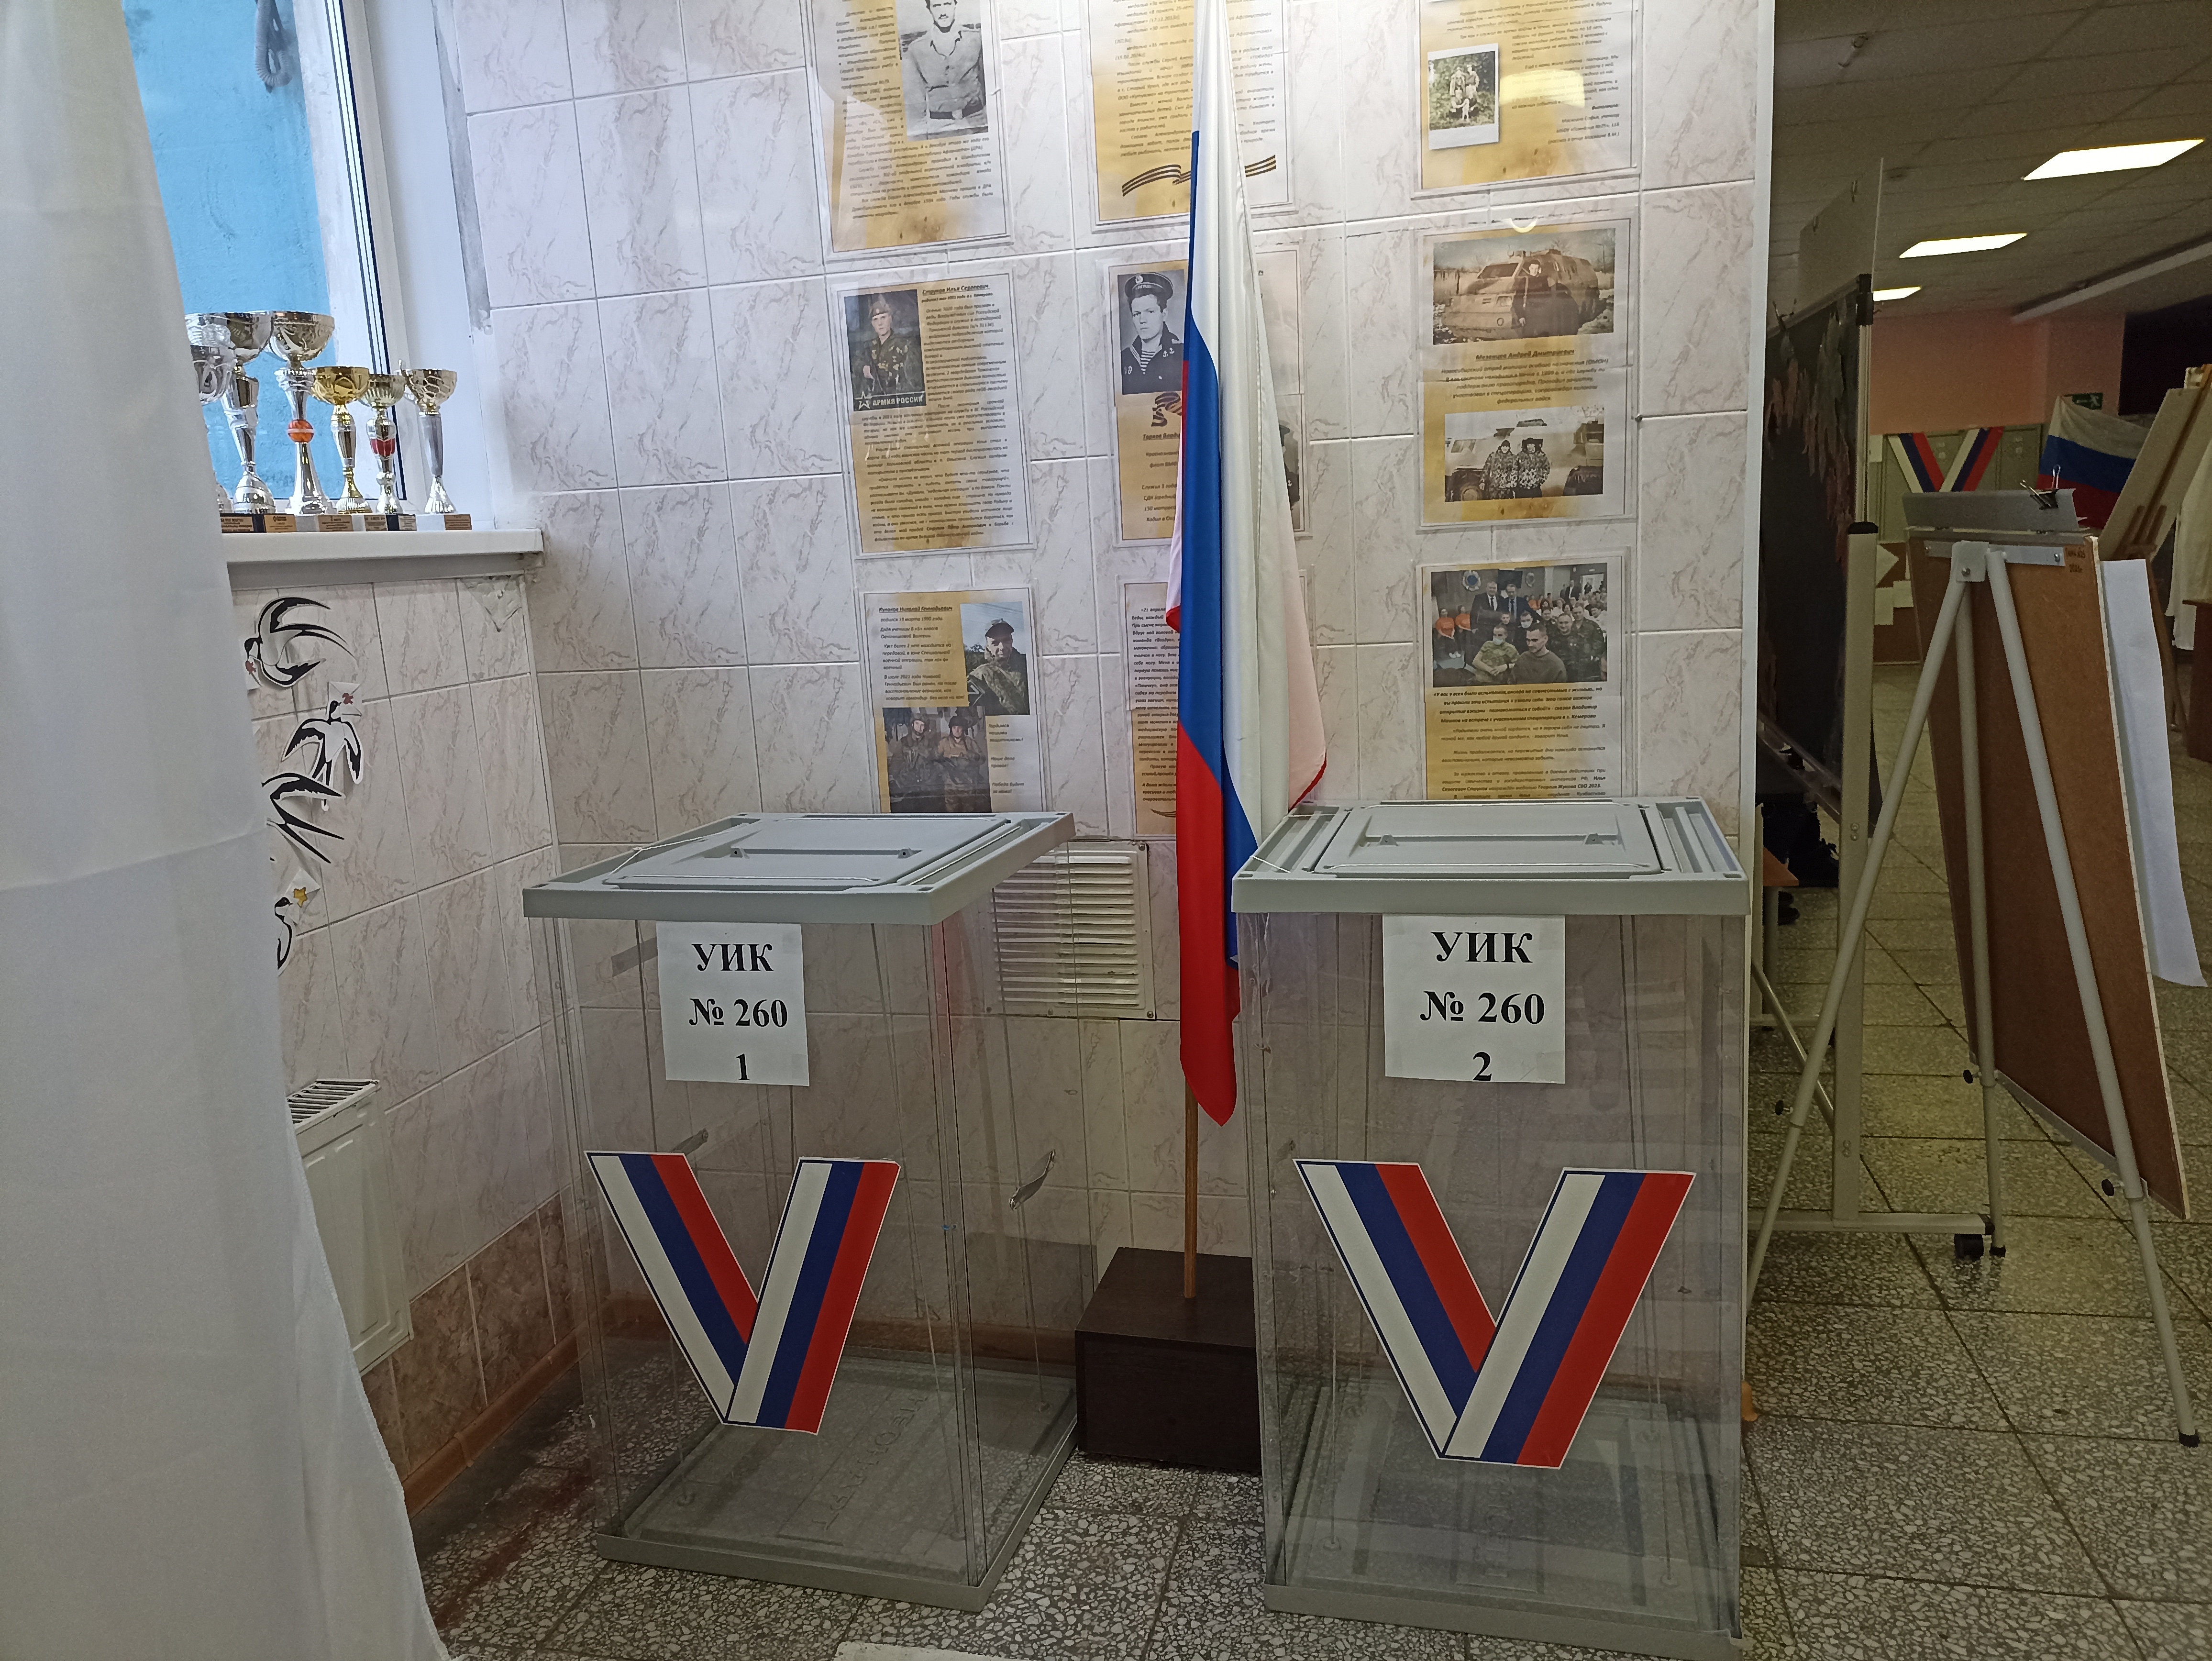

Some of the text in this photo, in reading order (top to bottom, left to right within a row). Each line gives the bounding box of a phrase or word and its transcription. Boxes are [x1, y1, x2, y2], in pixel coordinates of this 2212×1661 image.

[691, 943, 774, 971] УИК
[1431, 931, 1533, 963] УИК
[689, 998, 787, 1027] № 260
[1420, 991, 1545, 1024] № 260
[736, 1053, 750, 1080] 1
[1472, 1052, 1492, 1082] 2
